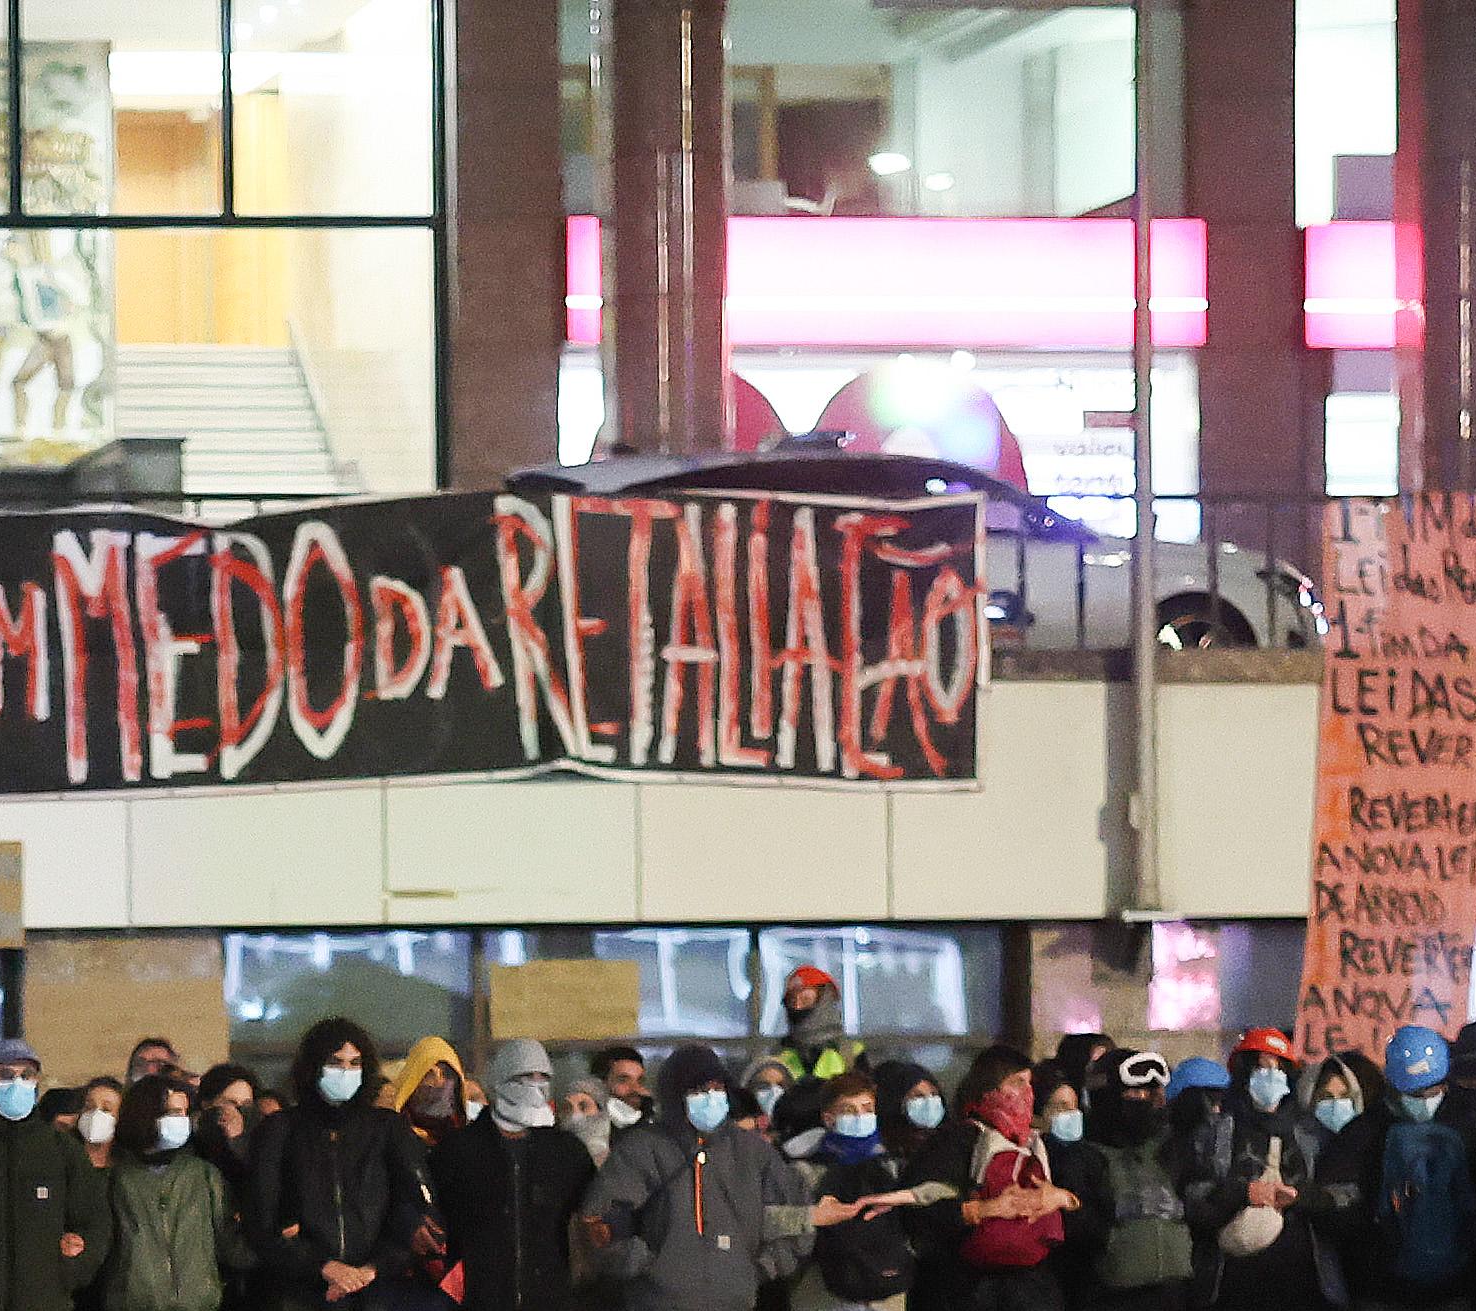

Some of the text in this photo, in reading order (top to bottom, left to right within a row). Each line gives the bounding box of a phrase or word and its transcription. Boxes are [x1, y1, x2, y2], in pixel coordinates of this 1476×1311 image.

[50, 520, 364, 784] MEDO
[364, 563, 507, 700] DA
[1316, 842, 1342, 878] A
[1302, 980, 1454, 1026] A NOVA
